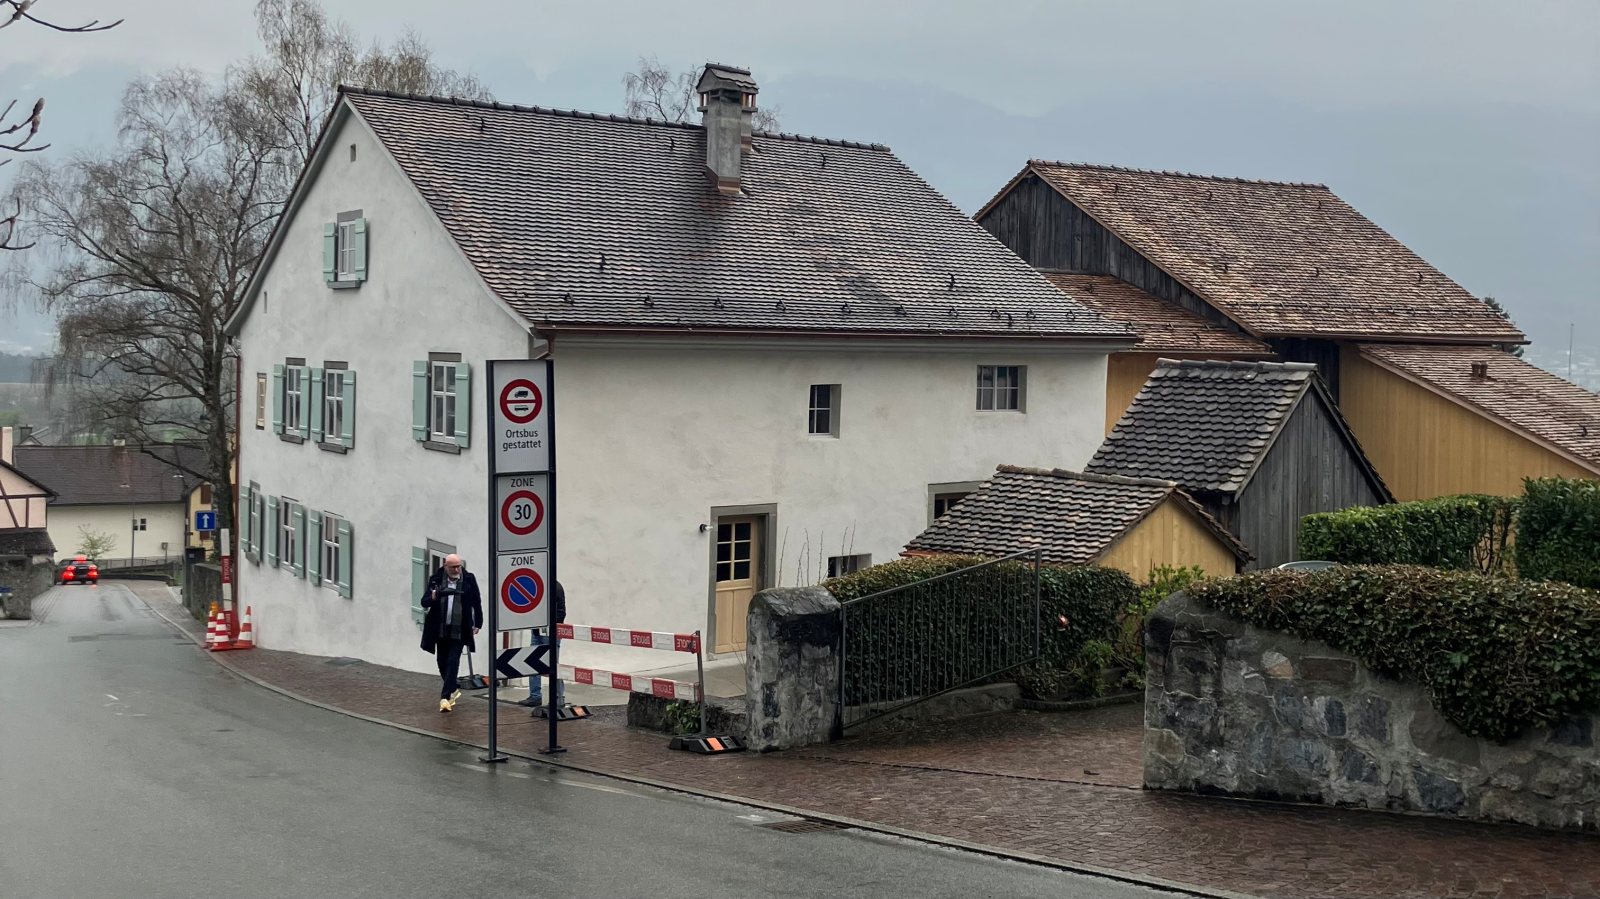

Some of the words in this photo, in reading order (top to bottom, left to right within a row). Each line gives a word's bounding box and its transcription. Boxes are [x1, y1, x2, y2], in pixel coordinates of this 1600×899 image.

[506, 428, 538, 438] Ortsbus
[502, 440, 541, 451] gestattet
[510, 478, 534, 487] ZONE
[514, 504, 531, 520] 30
[511, 556, 534, 566] ZONE
[676, 638, 697, 650] BOGLE
